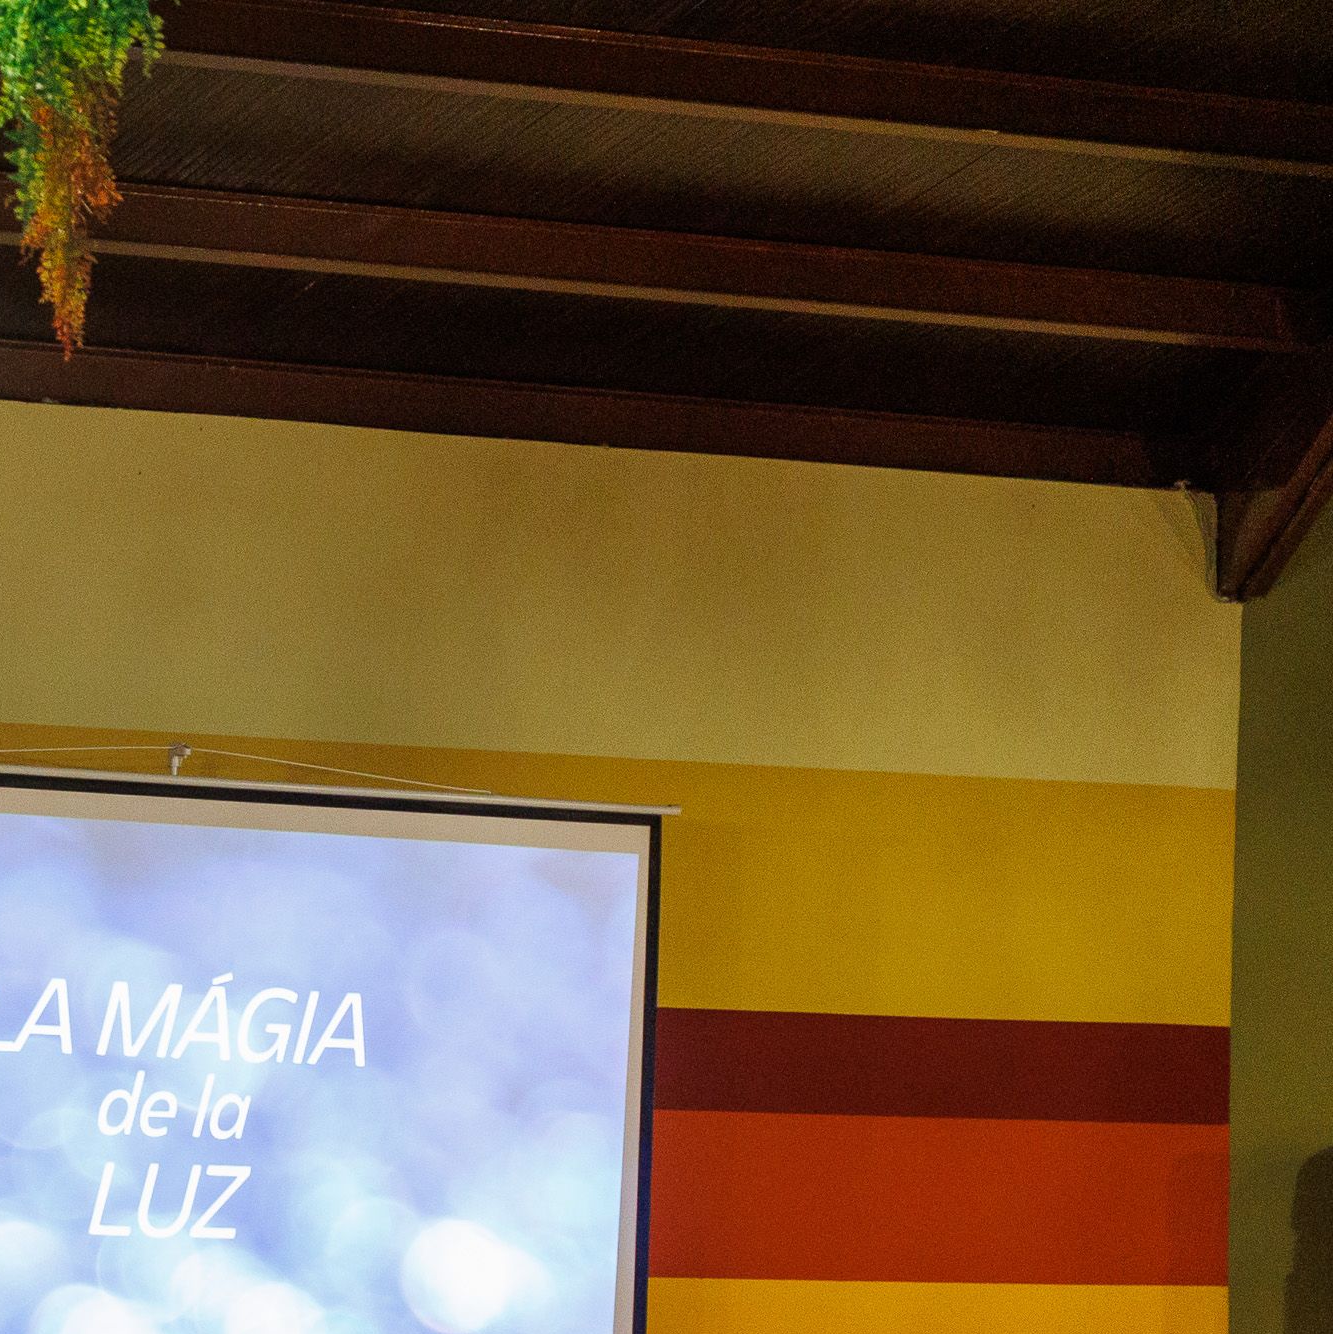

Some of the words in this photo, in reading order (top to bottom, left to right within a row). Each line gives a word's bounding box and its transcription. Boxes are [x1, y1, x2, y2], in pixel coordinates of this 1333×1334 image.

[96, 972, 366, 1068] MÁGIA
[97, 1070, 178, 1138] de
[191, 1073, 252, 1140] la
[88, 1162, 252, 1240] LUZ
